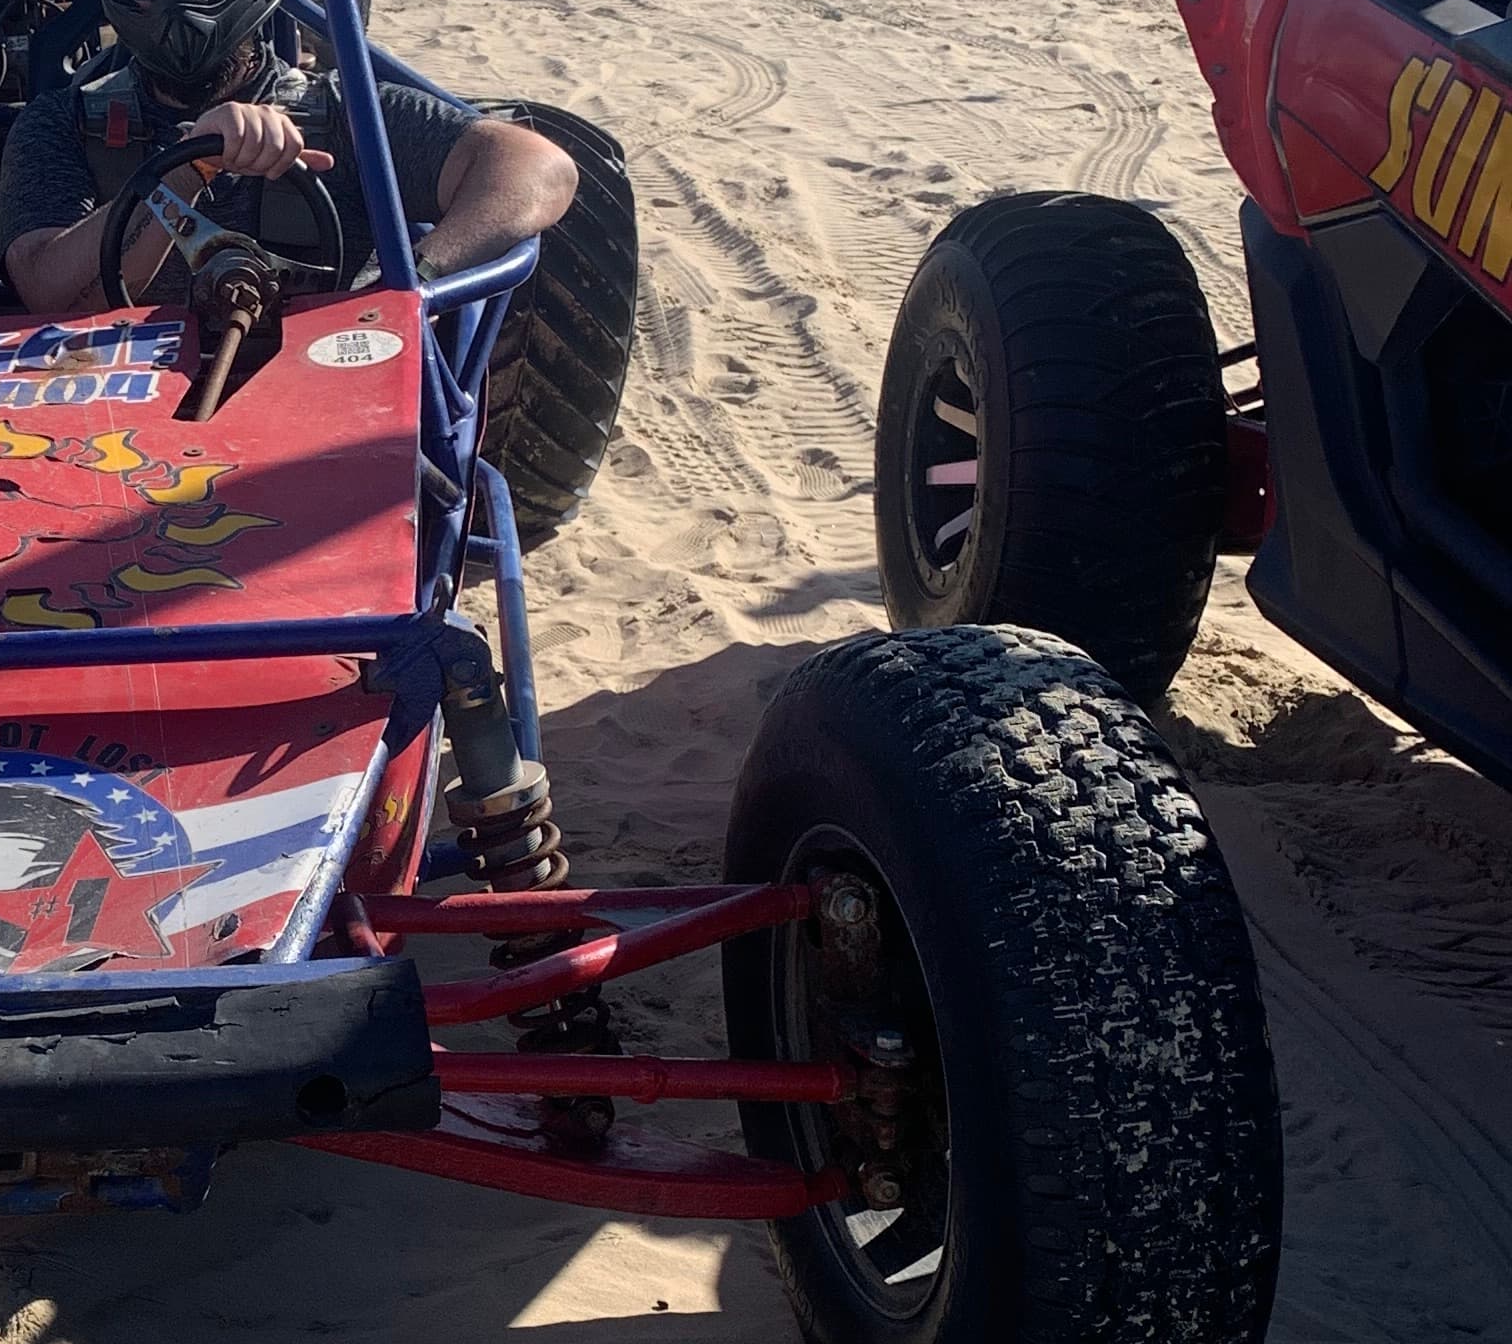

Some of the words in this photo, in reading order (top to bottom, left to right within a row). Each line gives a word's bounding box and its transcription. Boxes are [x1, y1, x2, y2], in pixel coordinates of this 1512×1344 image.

[335, 333, 368, 342] SB
[333, 354, 373, 363] 404
[74, 734, 173, 787] LOST
